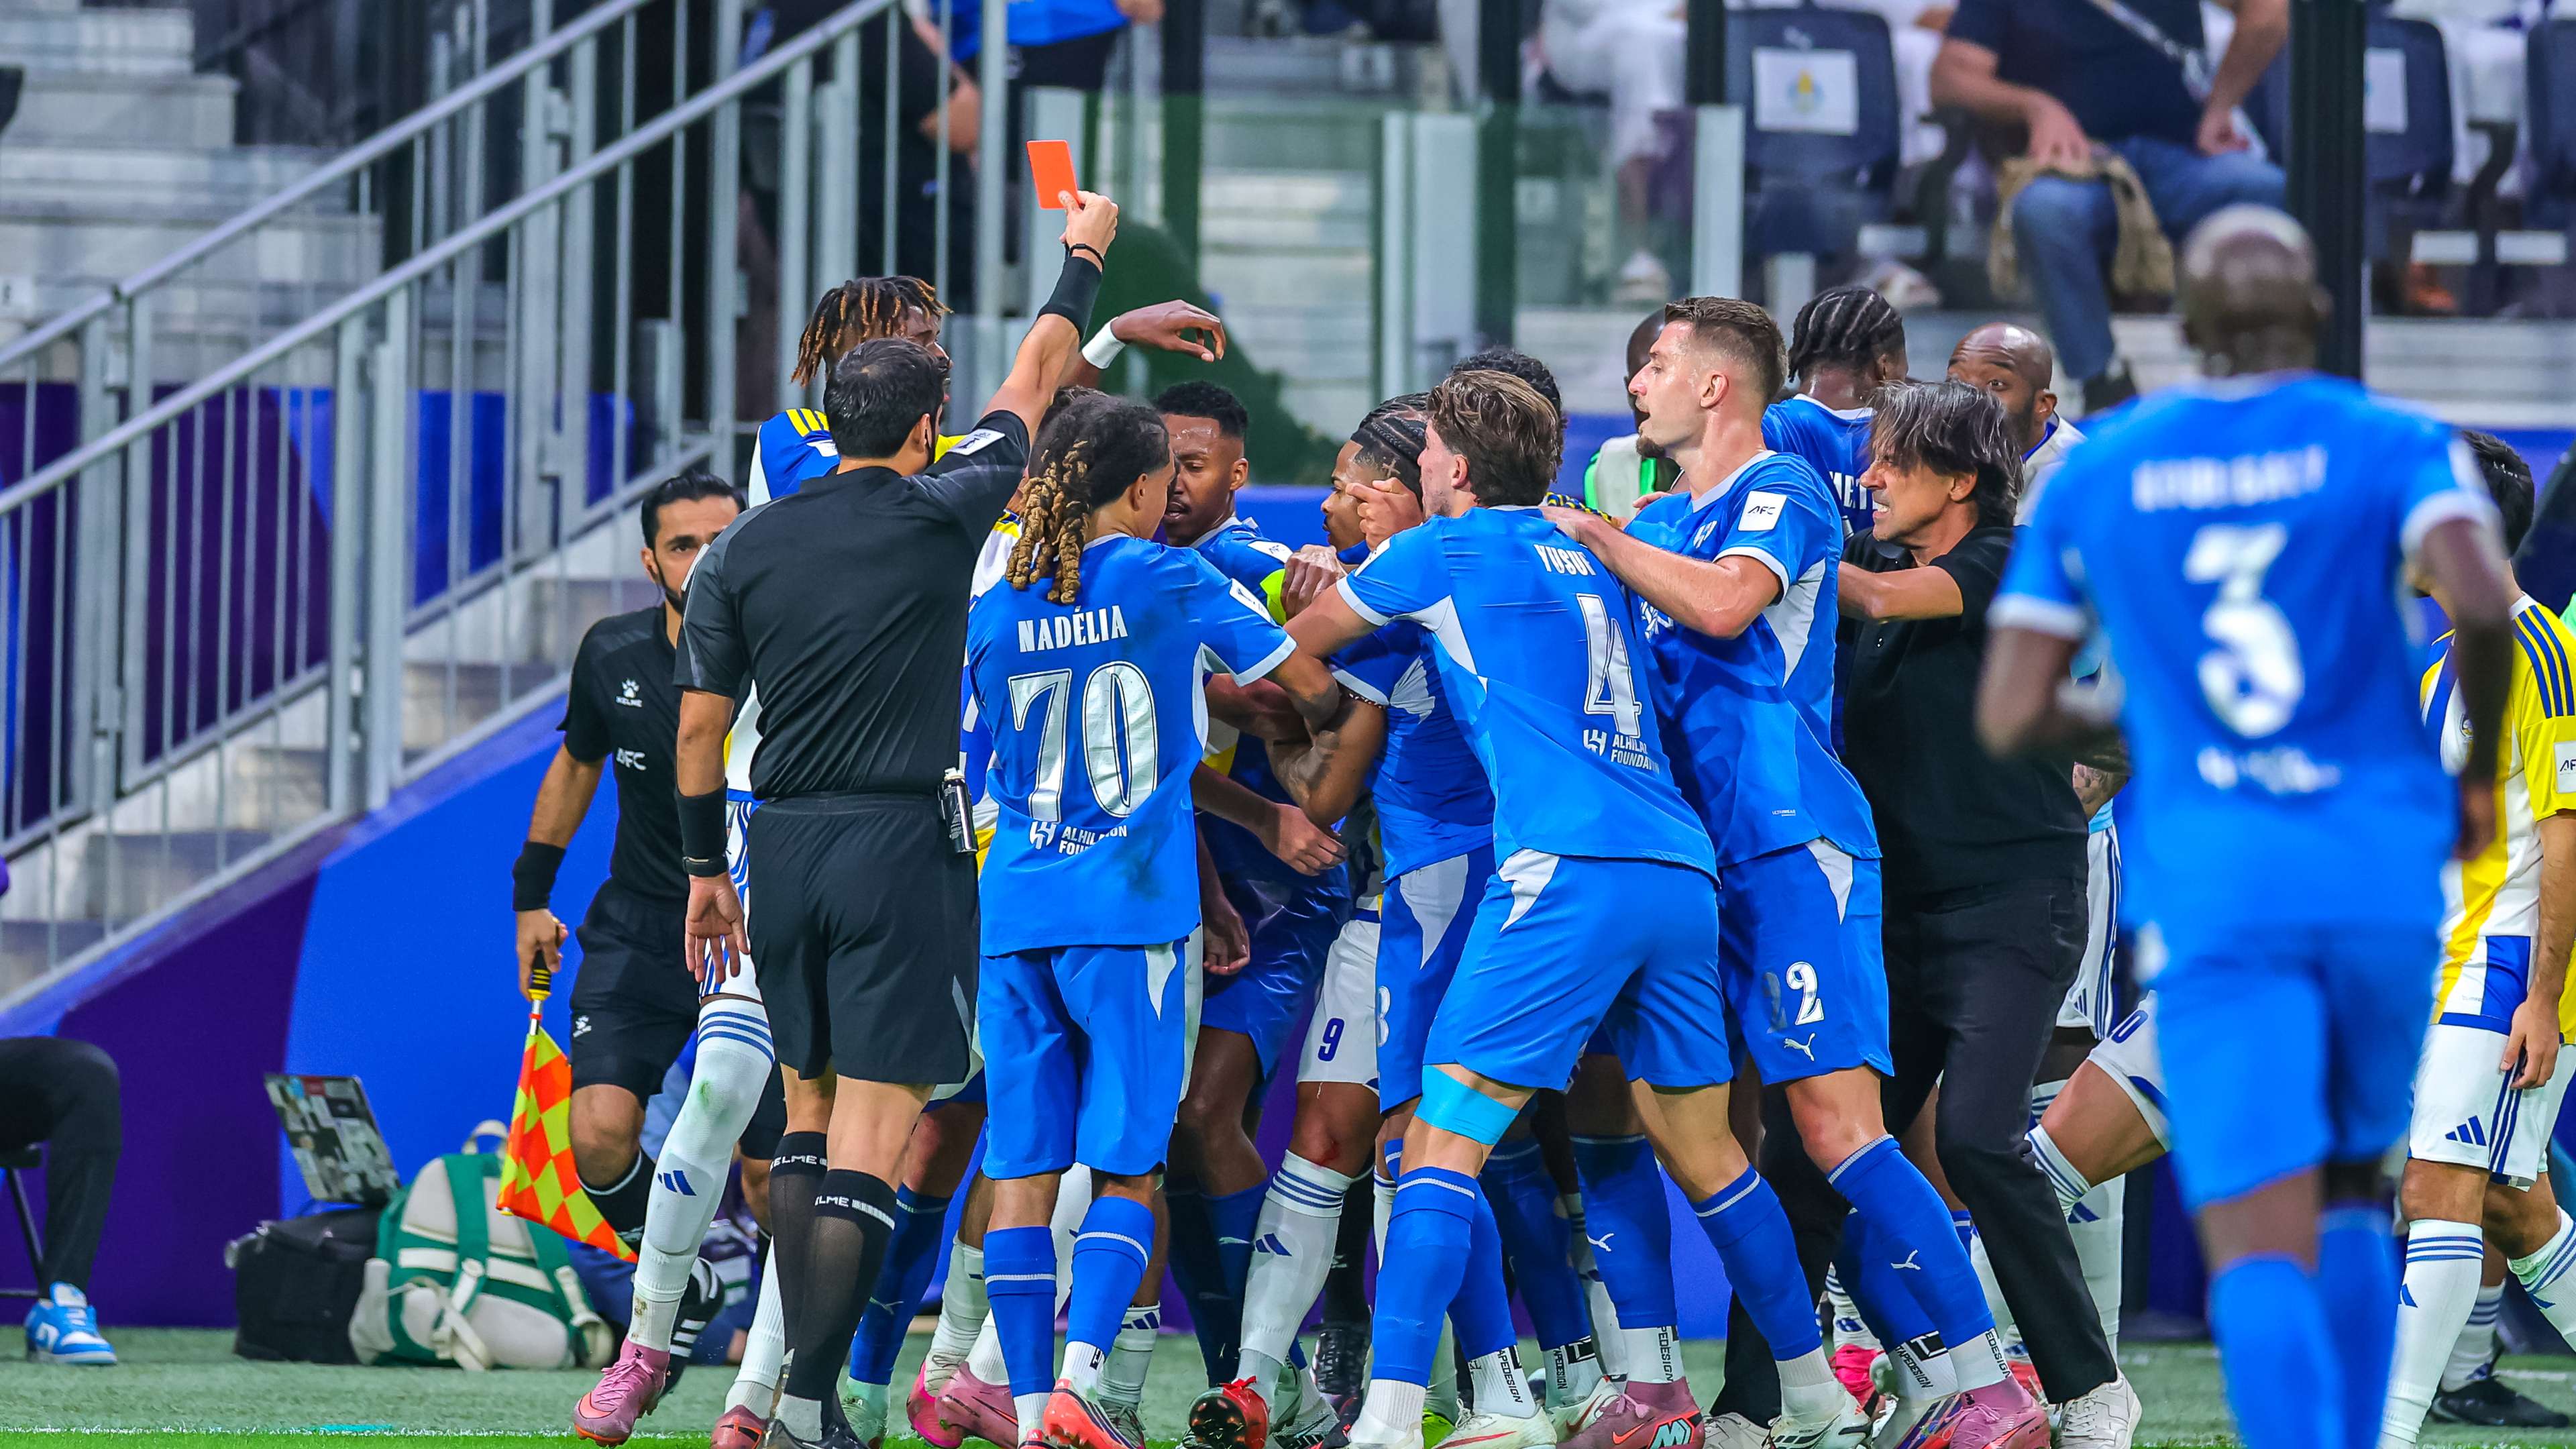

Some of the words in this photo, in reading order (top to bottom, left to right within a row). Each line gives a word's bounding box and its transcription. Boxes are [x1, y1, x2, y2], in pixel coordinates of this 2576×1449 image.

[1748, 506, 1776, 515] AFC
[1829, 471, 1879, 510] MET
[1534, 544, 1597, 576] YUSUF
[1018, 605, 1128, 653] NADÉLIA
[2184, 523, 2305, 738] 3
[1576, 593, 1642, 738] 4
[616, 747, 647, 771] AFC
[1008, 661, 1158, 823] 70
[1318, 1018, 1345, 1062] 9
